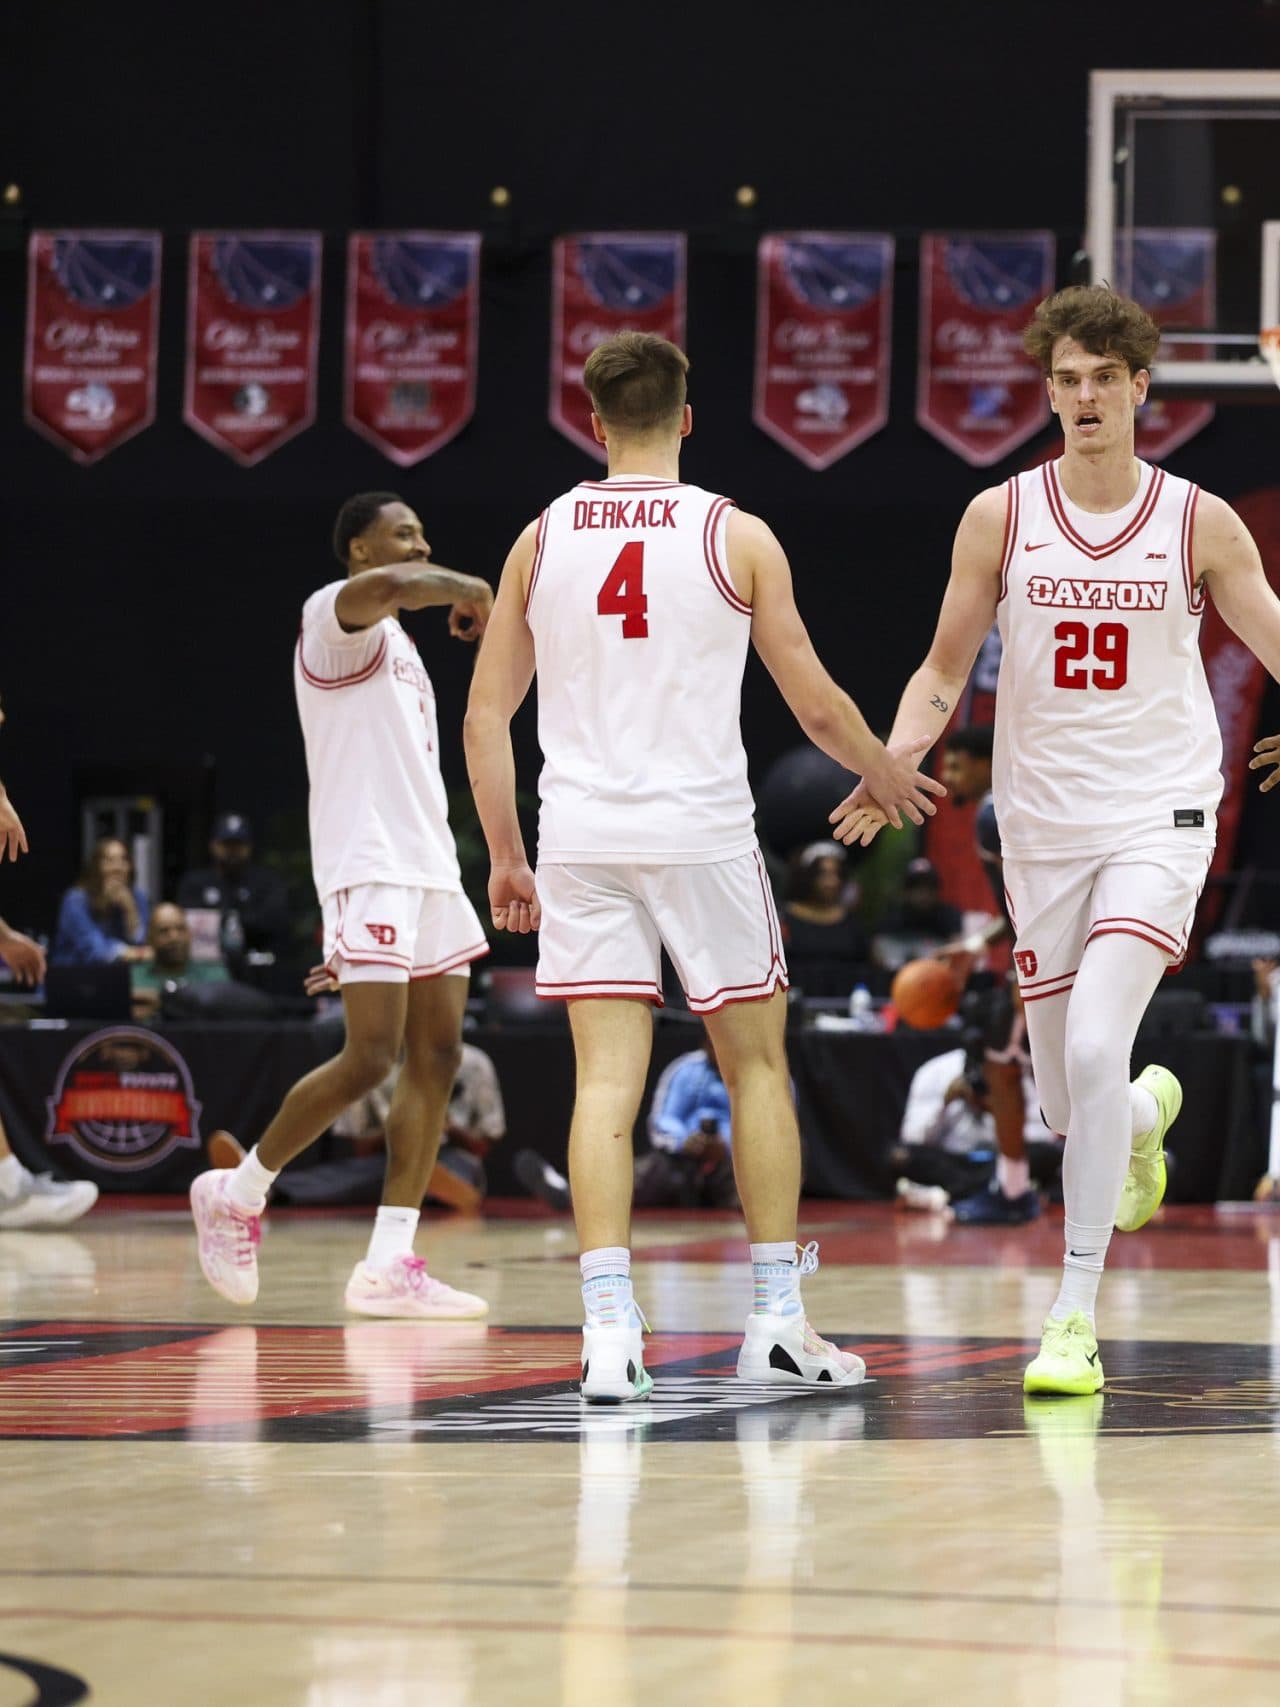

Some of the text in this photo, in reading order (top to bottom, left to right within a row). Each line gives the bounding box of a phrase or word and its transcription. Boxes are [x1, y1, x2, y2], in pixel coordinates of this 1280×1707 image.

[573, 499, 680, 531] DERKACK
[597, 541, 648, 639] 4
[1027, 575, 1168, 611] DAYTON
[1054, 621, 1129, 690] 29
[930, 694, 948, 713] 29
